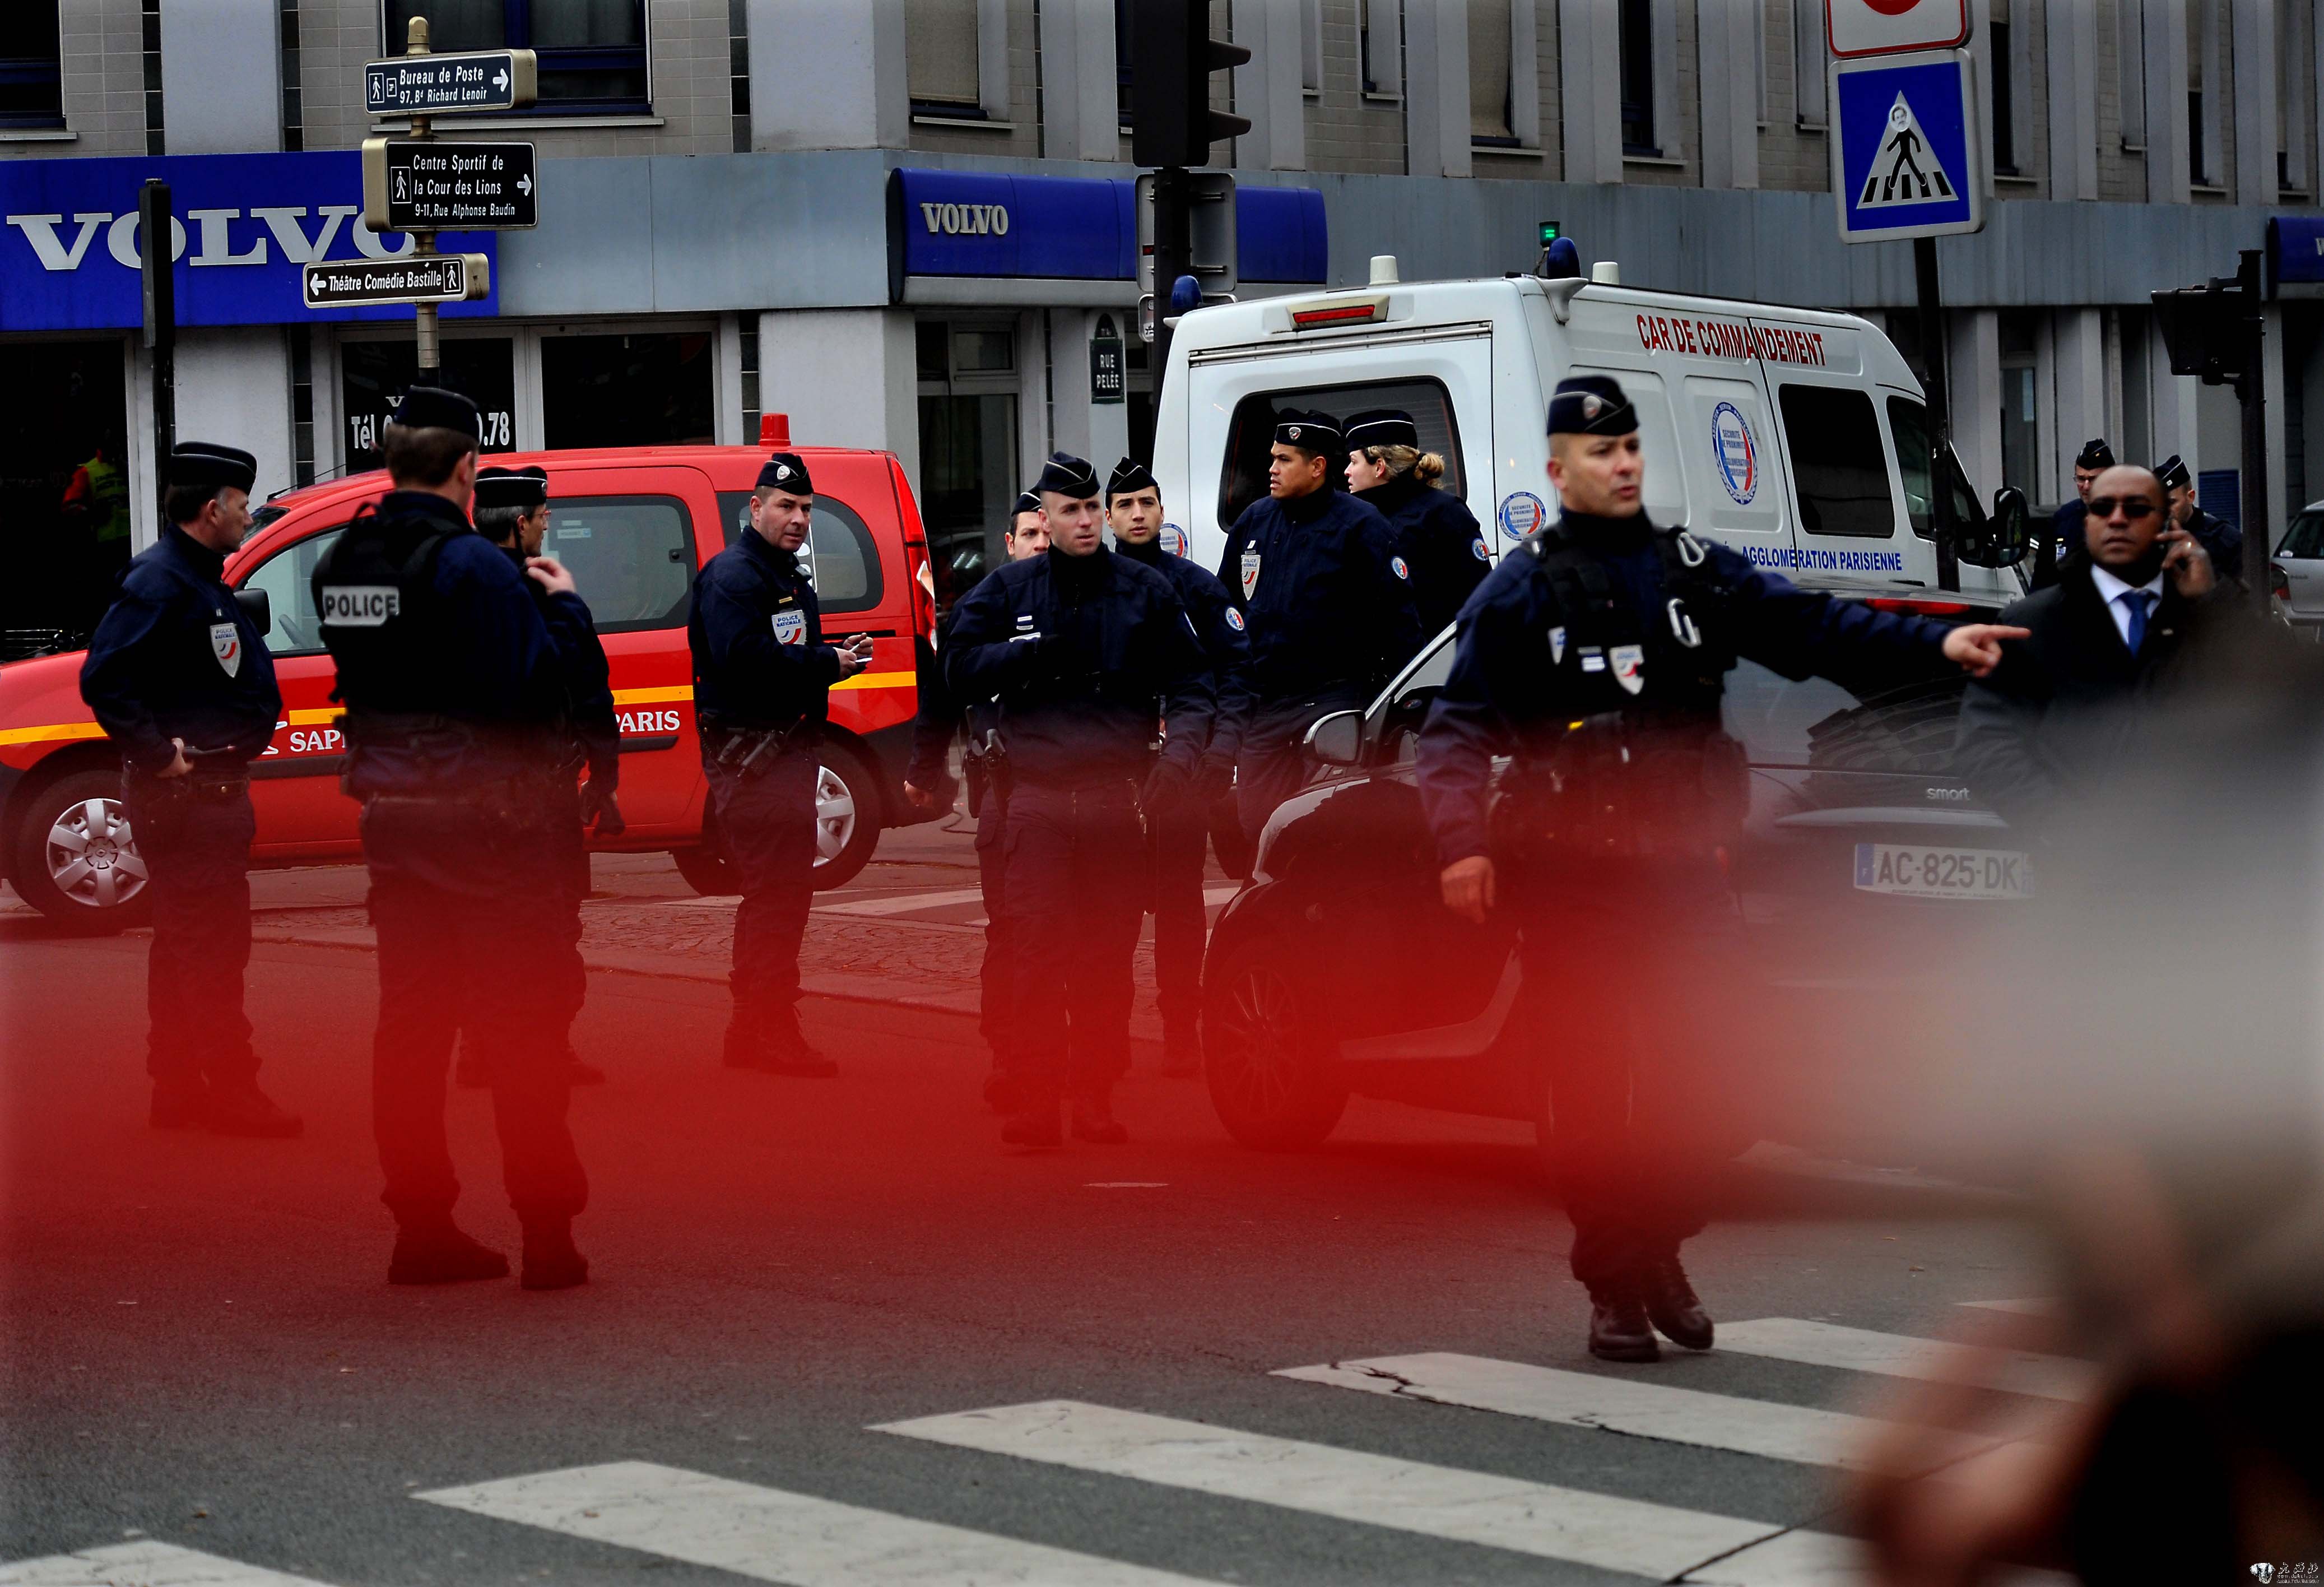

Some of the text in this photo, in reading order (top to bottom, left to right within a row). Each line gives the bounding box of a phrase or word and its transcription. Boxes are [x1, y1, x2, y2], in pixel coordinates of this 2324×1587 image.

[400, 66, 484, 85] Bureau de Poste
[427, 87, 458, 102] Richard
[462, 86, 487, 100] Lenoir
[413, 154, 503, 174] Centre Sportif de
[414, 179, 501, 194] la Cour des Lions
[452, 203, 486, 219] Alphonse
[490, 203, 515, 216] Baudin
[920, 203, 1008, 235] VOLVO
[329, 271, 441, 291] Théâtre Comédie Bastille
[1636, 314, 1826, 366] CAR DE COMMANDEMENT
[1100, 354, 1115, 368] RUE
[1096, 370, 1119, 388] PELÉE
[351, 414, 375, 449] Tél
[1742, 545, 1903, 571] AGGLOMÉRATION PARISIENNE
[324, 593, 397, 617] POLICE
[290, 730, 346, 752] SAP
[1927, 787, 1970, 801] smart
[1877, 851, 2020, 890] AC-825-DK
